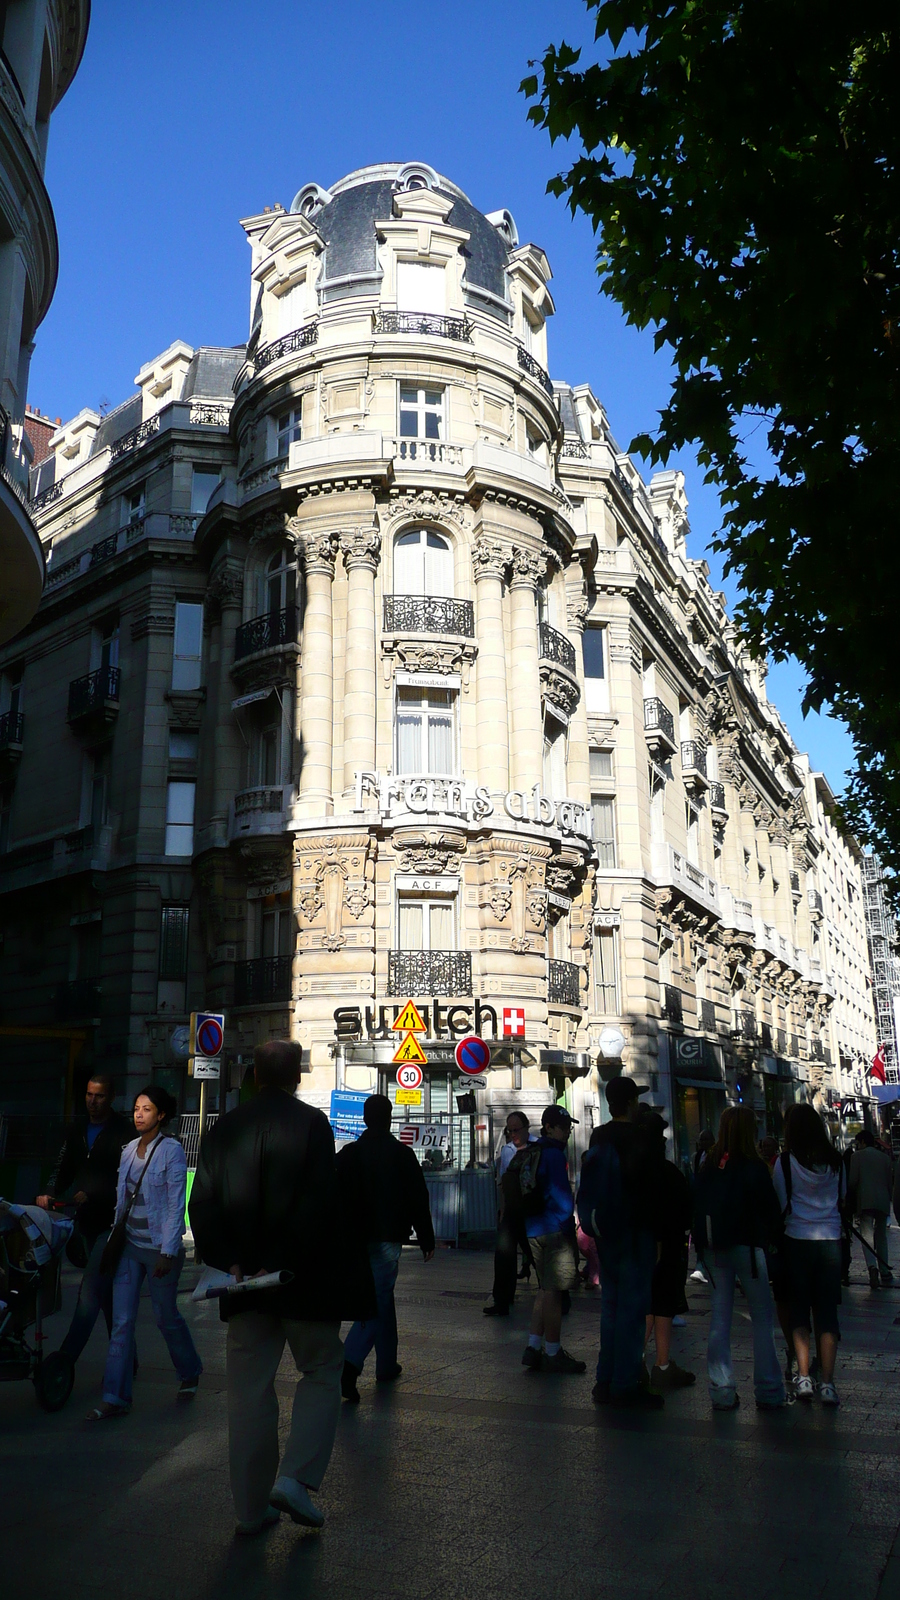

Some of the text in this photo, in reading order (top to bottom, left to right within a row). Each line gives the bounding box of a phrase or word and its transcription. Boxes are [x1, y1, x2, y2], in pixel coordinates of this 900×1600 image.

[350, 771, 595, 840] Fransaban
[676, 1058, 703, 1066] COURIR
[403, 1071, 416, 1082] 30
[421, 1134, 447, 1148] DLE
